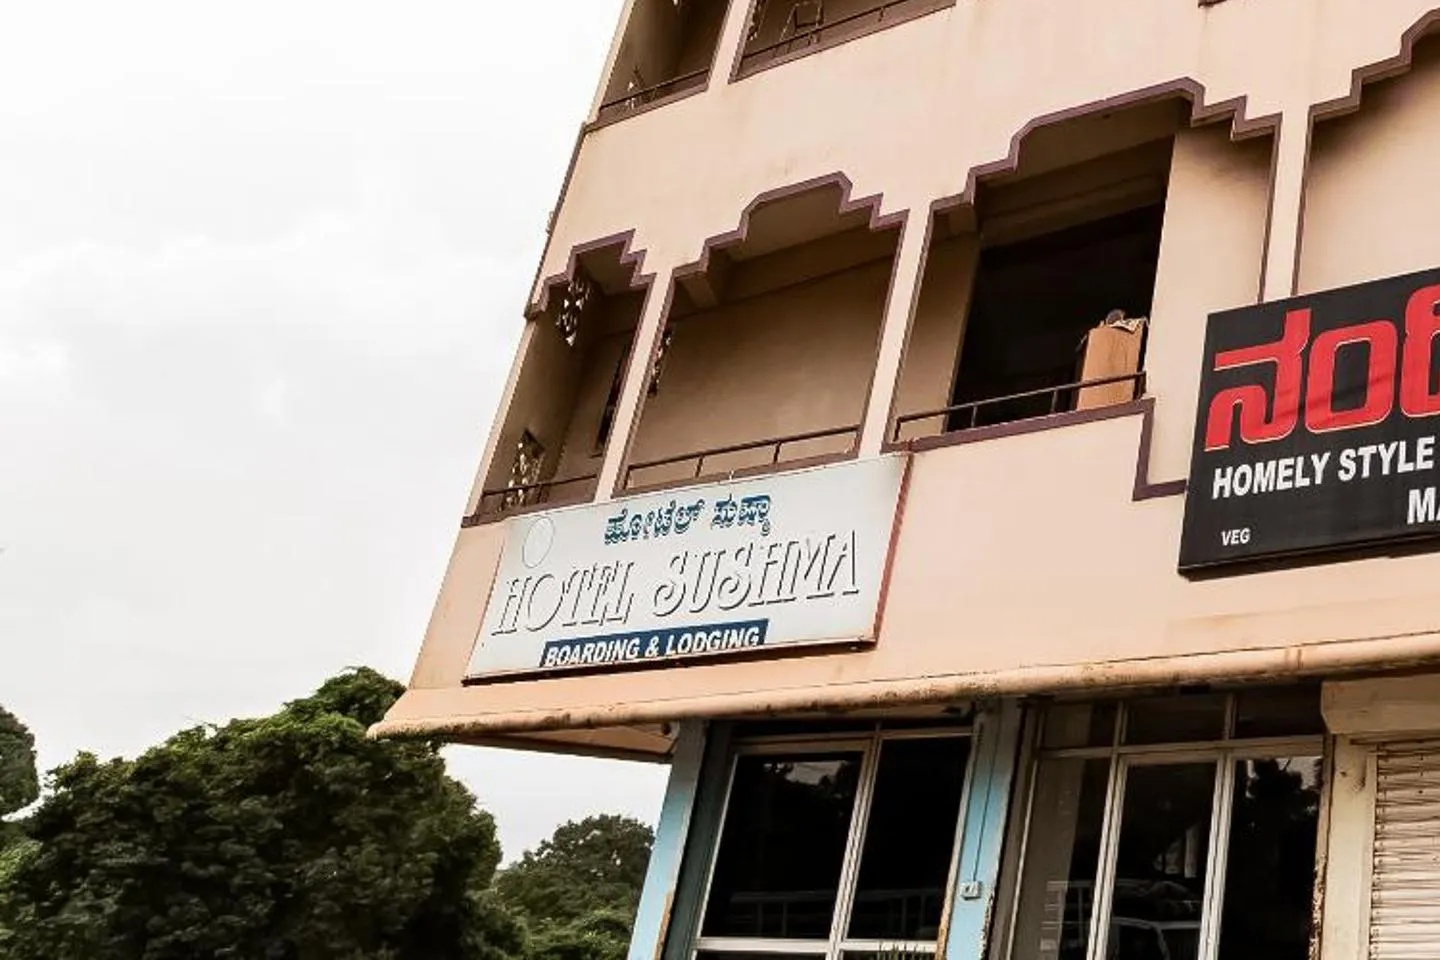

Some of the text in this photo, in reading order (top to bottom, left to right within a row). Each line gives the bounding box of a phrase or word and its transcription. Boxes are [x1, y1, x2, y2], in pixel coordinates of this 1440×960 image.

[1212, 451, 1331, 500] HOMELY
[1337, 435, 1436, 482] STYLE
[604, 499, 705, 544] ಹೋಟೆಲ್
[1221, 527, 1251, 546] VEG
[491, 530, 860, 637] HOTEL SUSHMA
[544, 626, 761, 667] BOARDING & LODGING
